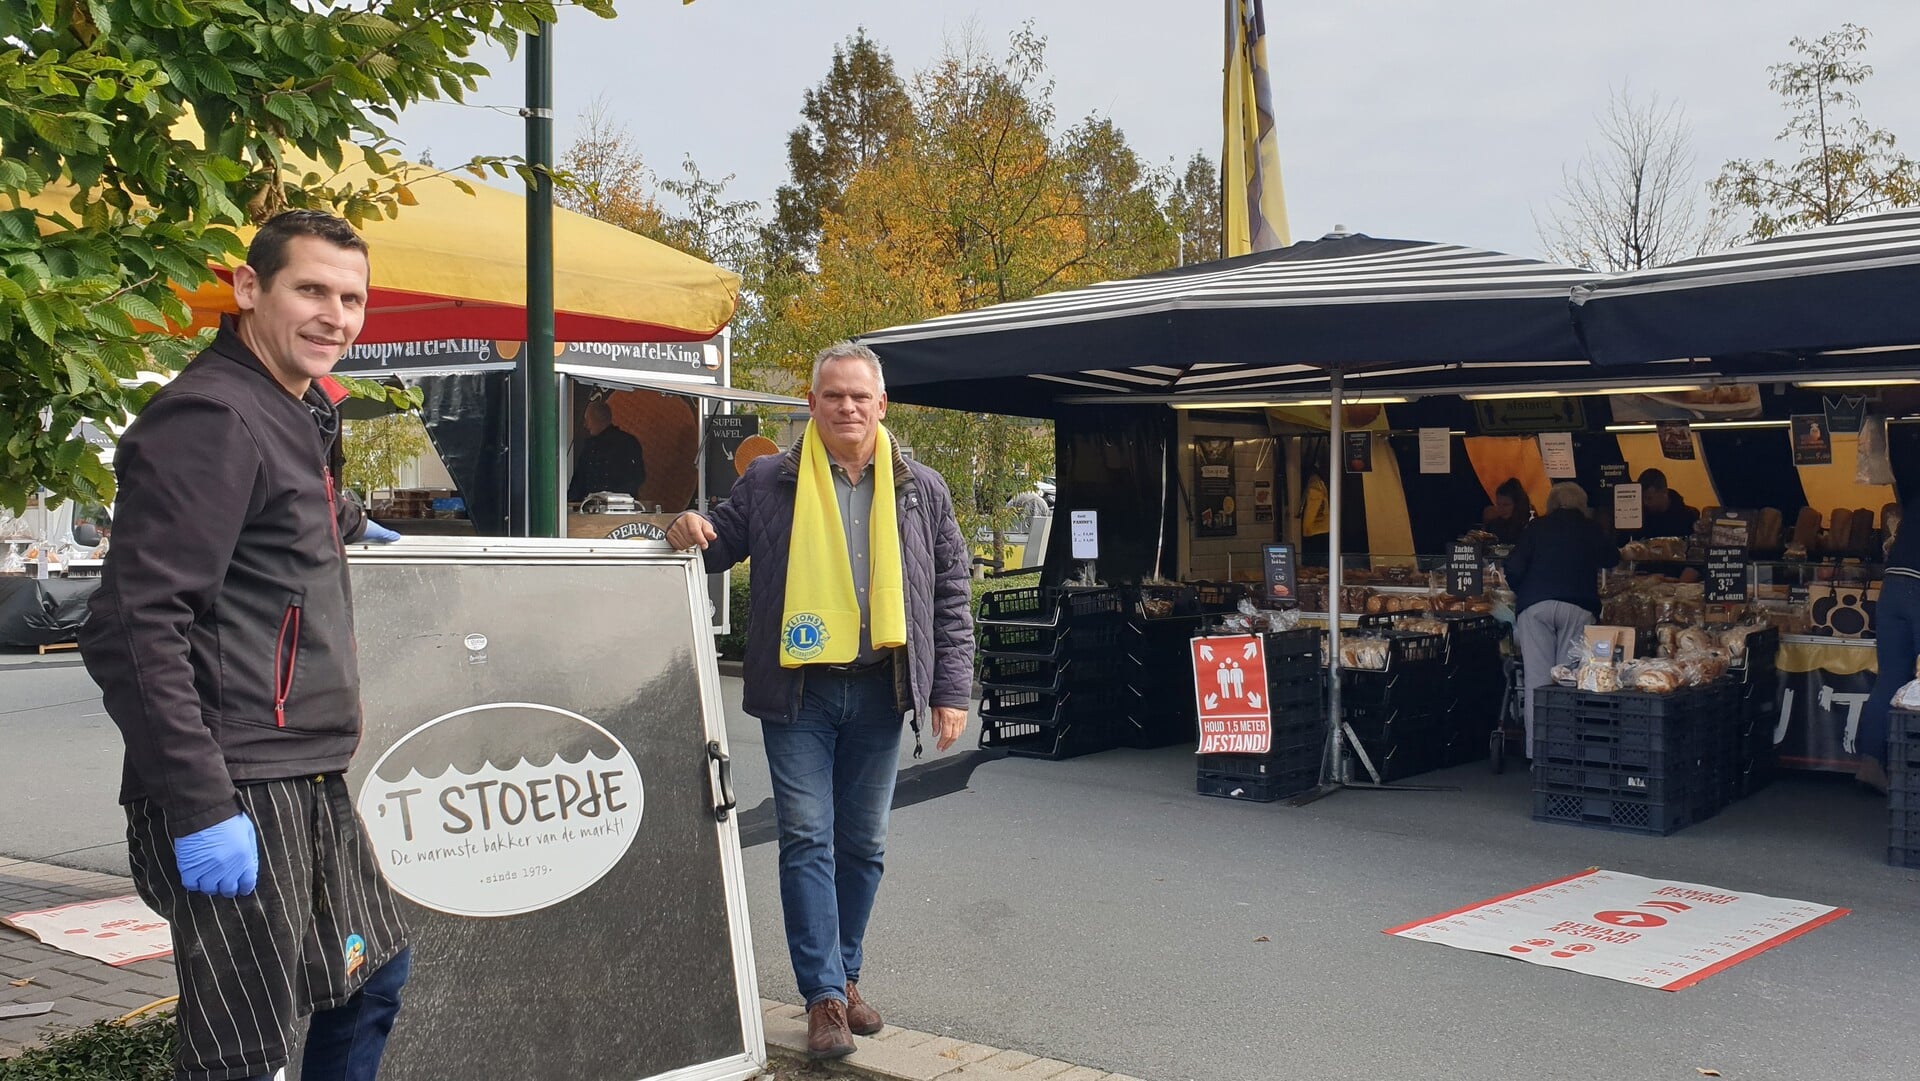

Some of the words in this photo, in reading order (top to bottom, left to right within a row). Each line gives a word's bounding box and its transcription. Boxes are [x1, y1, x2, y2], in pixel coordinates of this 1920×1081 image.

[569, 342, 701, 369] Stroopwafel-King
[713, 418, 742, 427] SUPER
[713, 429, 743, 438] WAFEL
[1454, 545, 1474, 553] Zachte
[1453, 553, 1475, 562] puntjes
[1710, 570, 1716, 578] 3
[791, 615, 820, 625] LIONS
[799, 627, 813, 645] L
[1204, 721, 1225, 733] HOUD
[1226, 720, 1239, 734] 1,5
[1240, 720, 1266, 732] METER
[1203, 733, 1266, 753] AFSTAND!
[438, 770, 627, 834] STOEPJE
[390, 848, 413, 867] De
[416, 842, 480, 863] warmste
[483, 833, 532, 855] bakker
[536, 832, 558, 845] van
[561, 824, 577, 843] de
[580, 817, 625, 841] markt!
[1544, 926, 1631, 945] AFSTAND
[1557, 920, 1642, 939] BEWAAR
